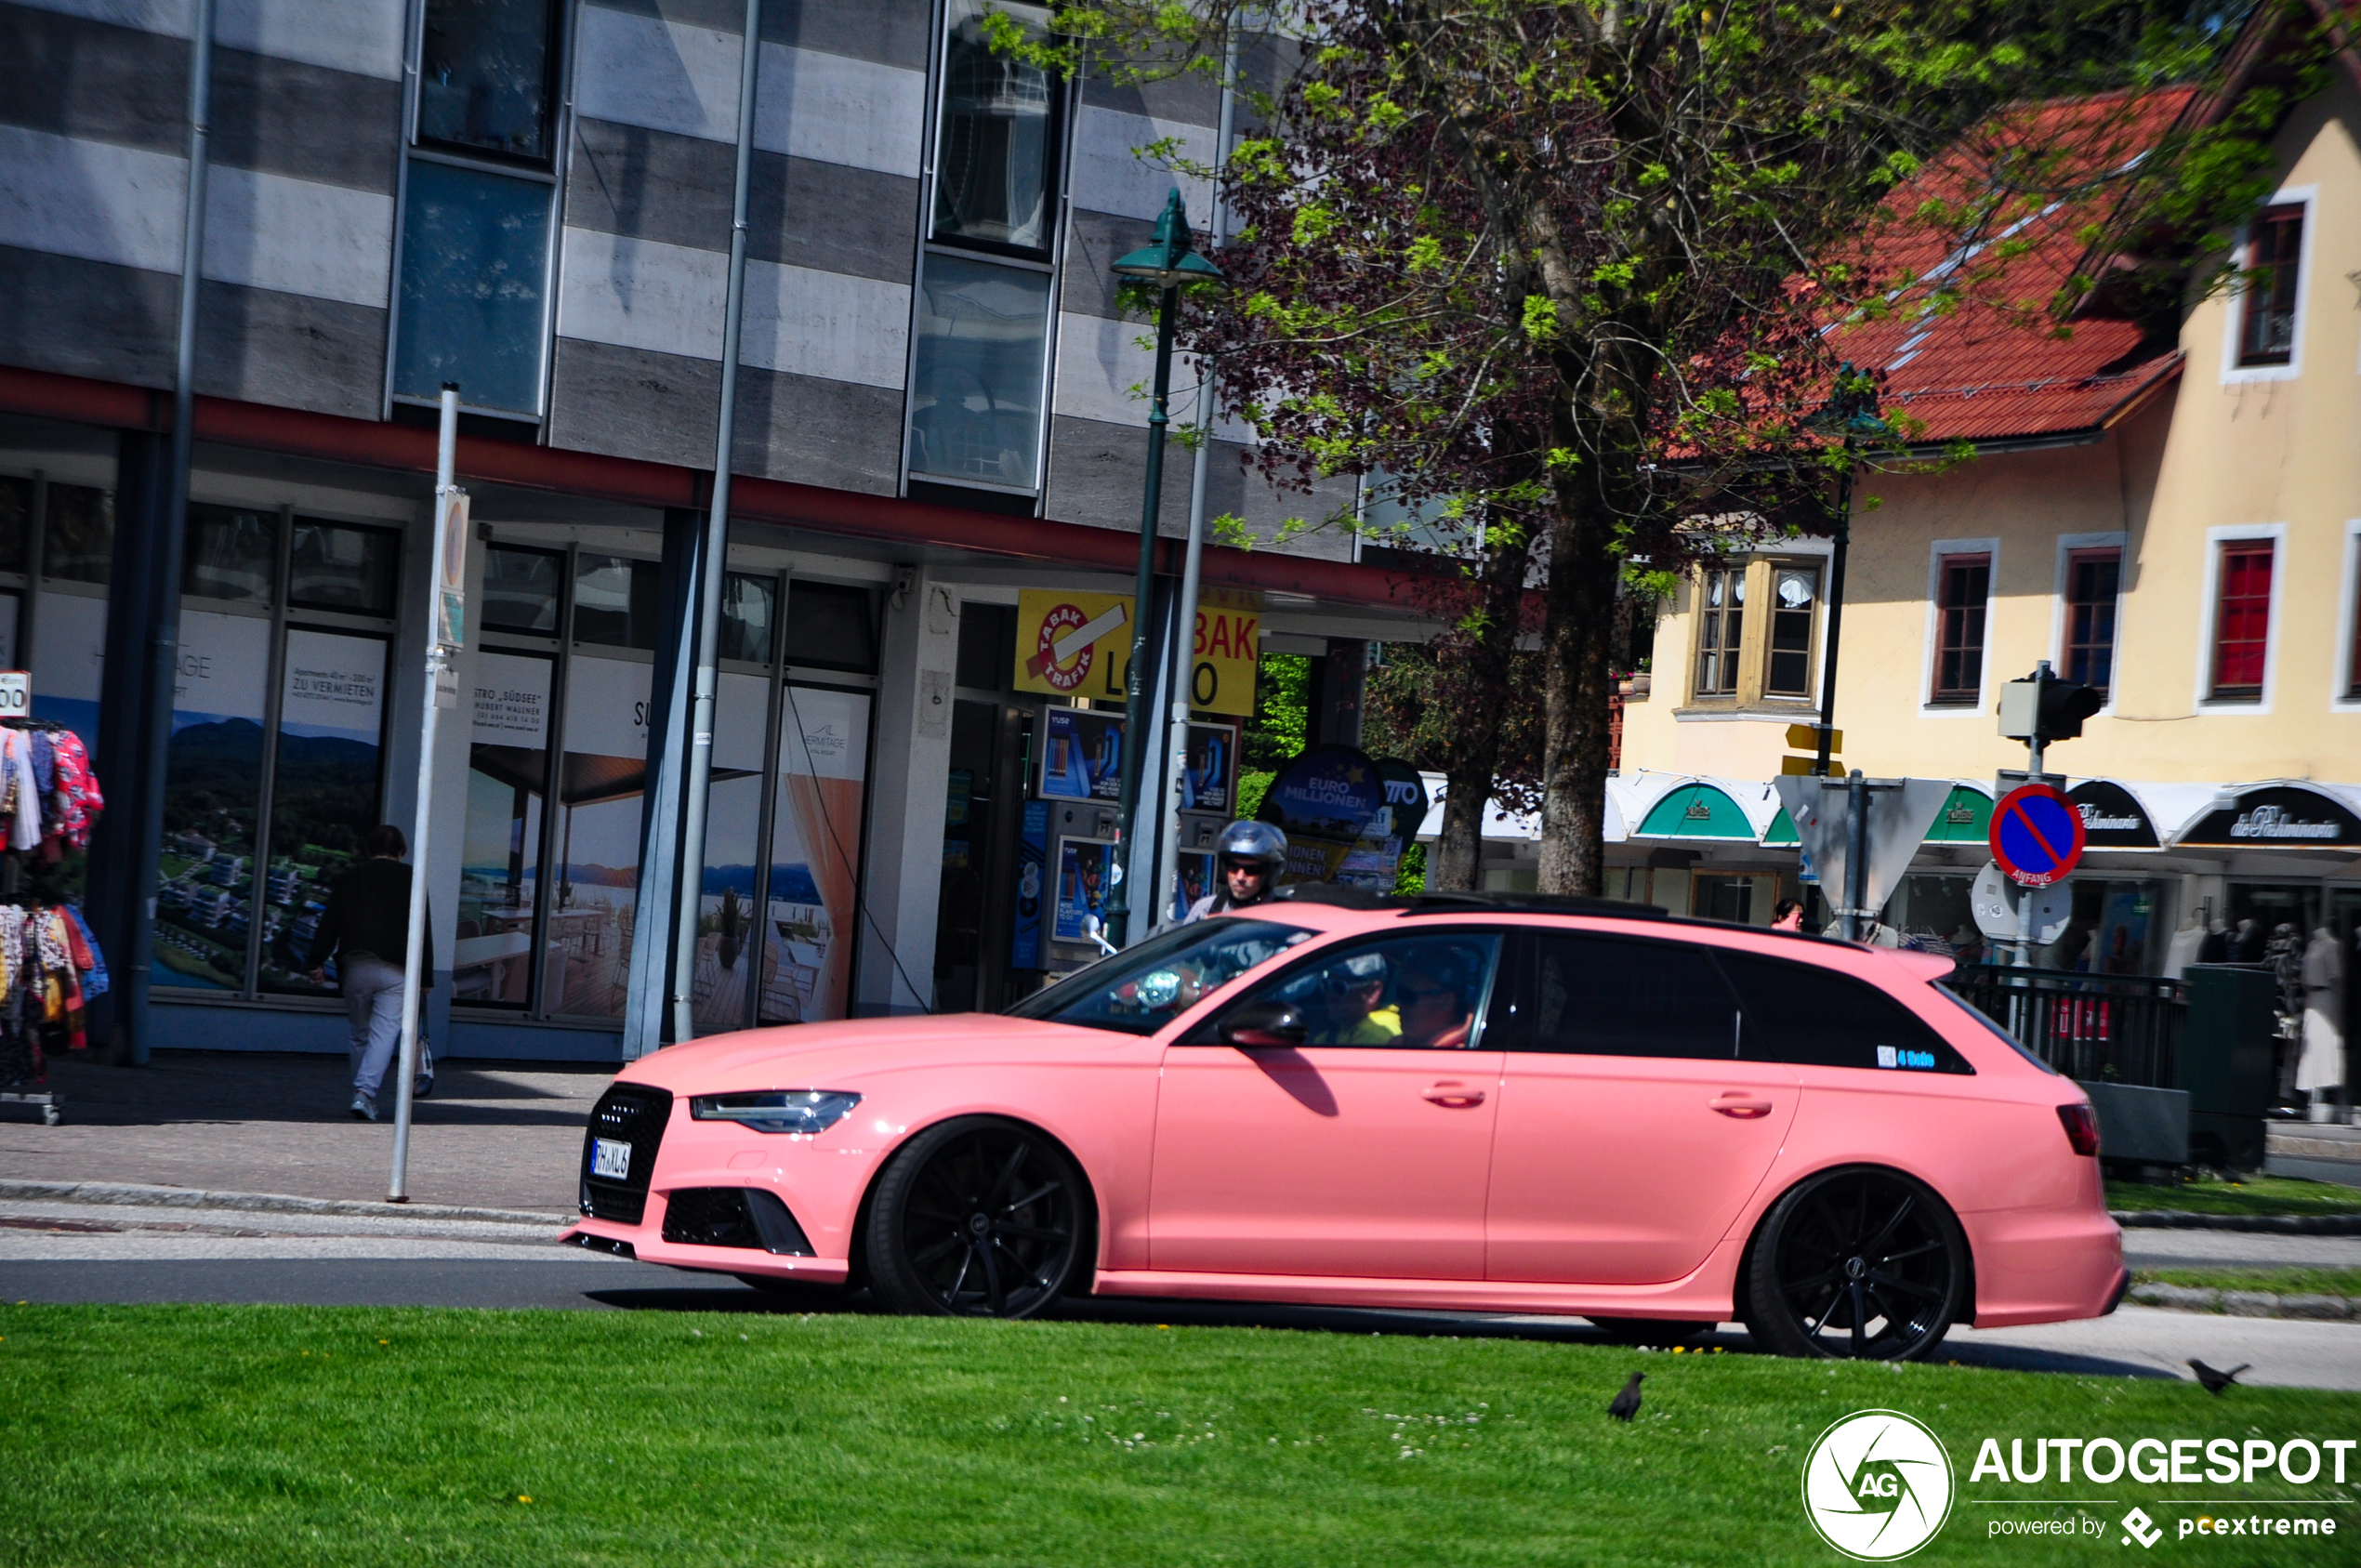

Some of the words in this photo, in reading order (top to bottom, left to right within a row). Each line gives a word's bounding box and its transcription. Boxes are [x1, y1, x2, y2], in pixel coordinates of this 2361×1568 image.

[1040, 609, 1081, 652] TABAK
[1045, 652, 1091, 688] TRAFIK
[293, 678, 309, 691] ZU
[312, 679, 375, 697] VERMIETEN
[475, 703, 503, 712] HUBERT
[507, 705, 540, 717] WALLNER
[1309, 777, 1350, 795] EURO
[1383, 780, 1419, 805] TTO
[1285, 785, 1367, 810] MILLIONEN
[2011, 869, 2051, 884] ANFANG
